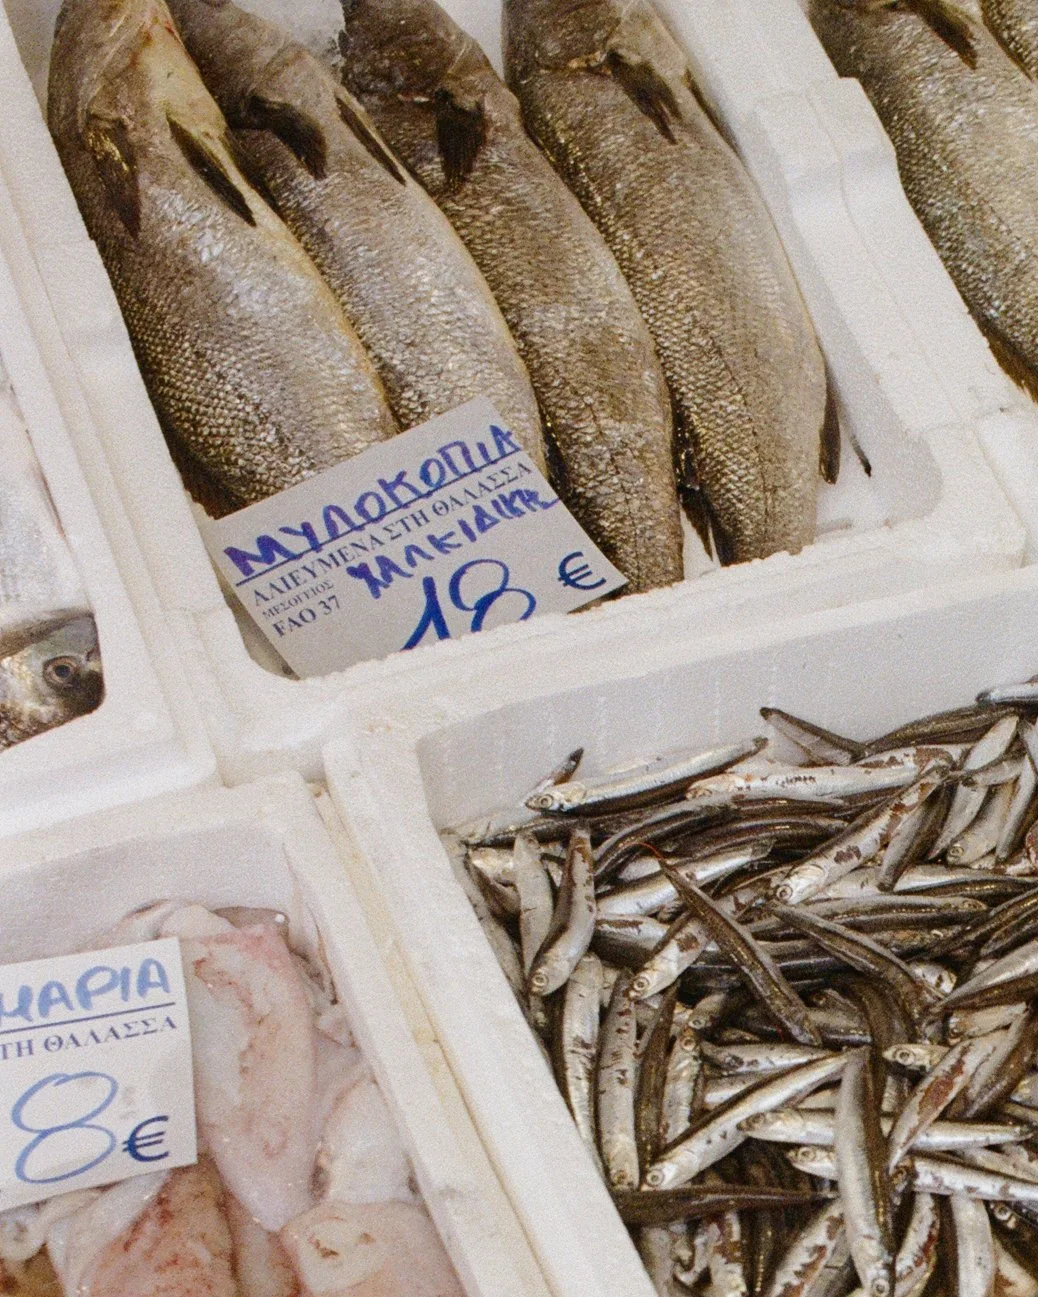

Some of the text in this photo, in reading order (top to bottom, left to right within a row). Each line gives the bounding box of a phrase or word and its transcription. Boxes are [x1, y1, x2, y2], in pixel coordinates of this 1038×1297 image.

[224, 423, 522, 578] ΜΥΛΟΚΟΠΙΑ
[253, 460, 532, 607] ΑΛΙΕΥΜΕΝΑ ΣΤΗ ΘΑΛΑΣΣΑ
[273, 594, 341, 638] FAO 37
[401, 550, 607, 650] 18 €
[43, 1015, 177, 1052] ΘΑΛΑΣΣΑ
[11, 1071, 170, 1184] 8 €
